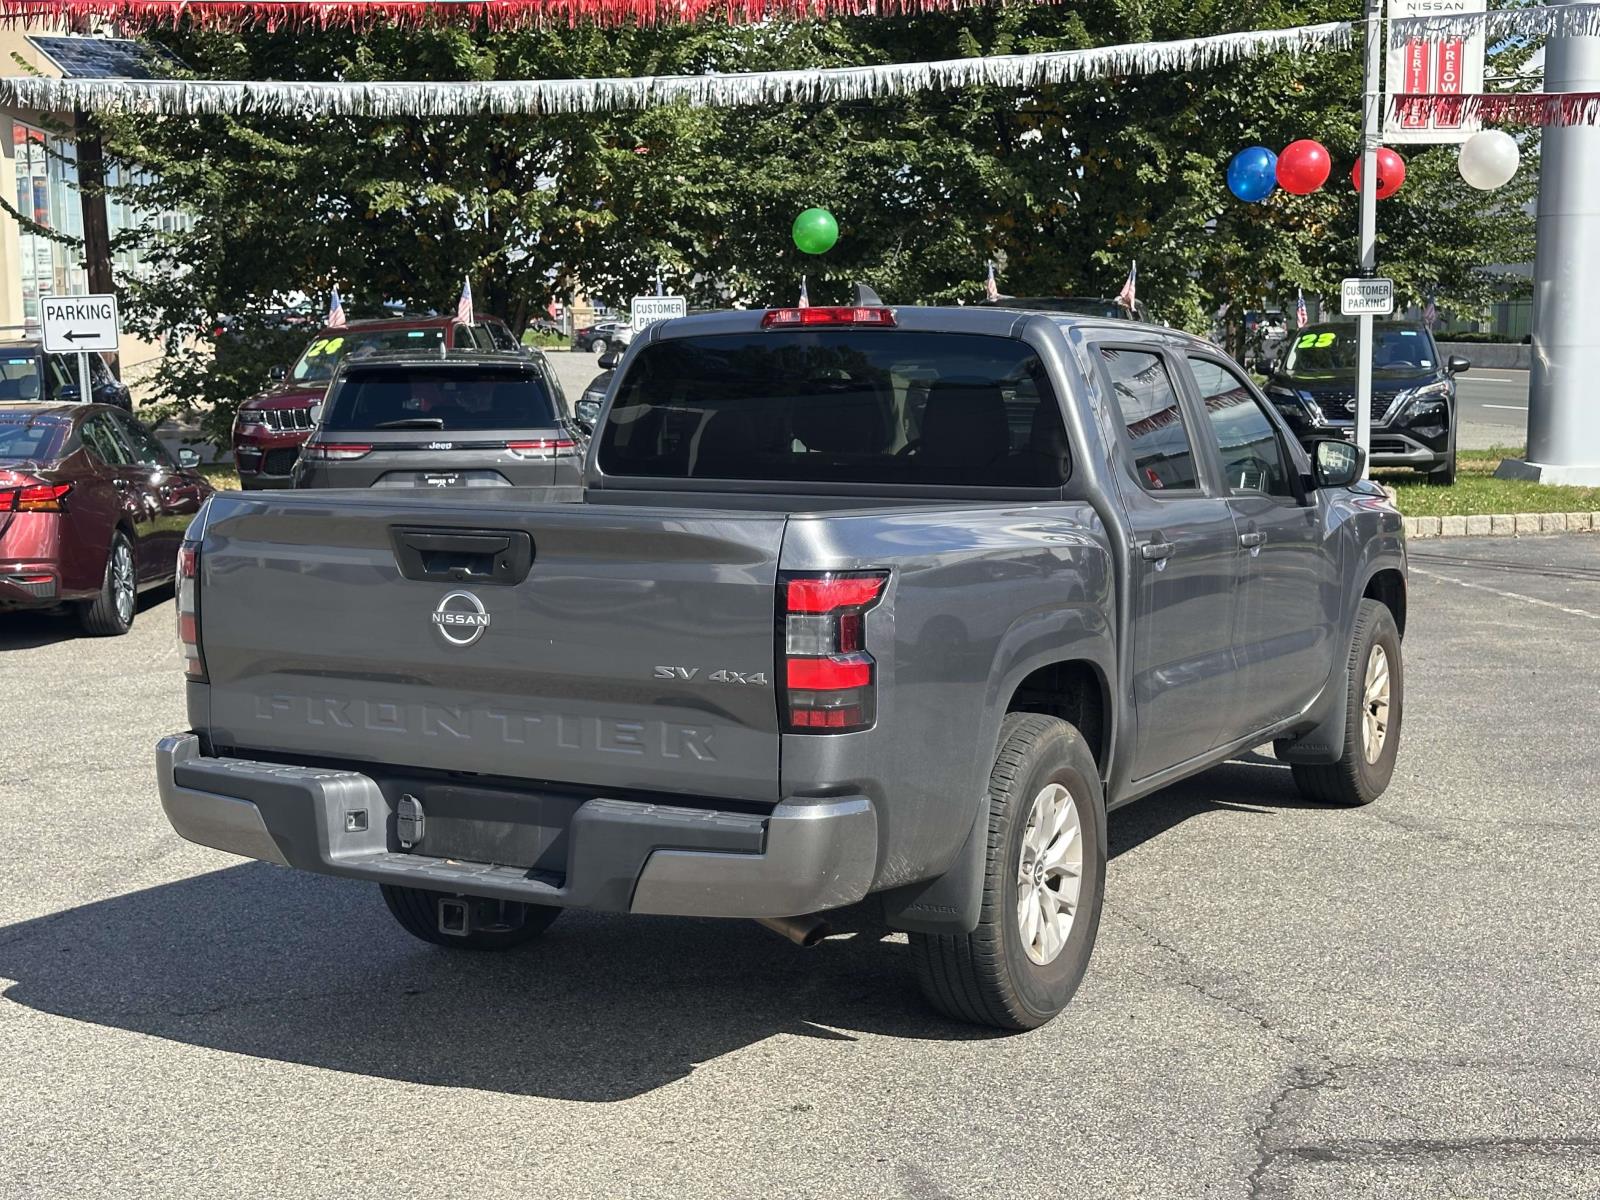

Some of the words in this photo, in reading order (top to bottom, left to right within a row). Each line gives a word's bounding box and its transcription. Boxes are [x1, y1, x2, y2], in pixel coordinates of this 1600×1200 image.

[1407, 2, 1464, 11] NISSAN
[1345, 285, 1389, 296] CUSTOMER
[636, 303, 682, 314] CUSTOMER
[1348, 298, 1386, 308] PARKING
[46, 304, 112, 321] PARKING
[1298, 332, 1336, 349] 23
[428, 442, 453, 450] Jeep
[432, 612, 488, 625] NISSAN
[654, 665, 700, 680] SV
[254, 694, 717, 762] FRONTIER
